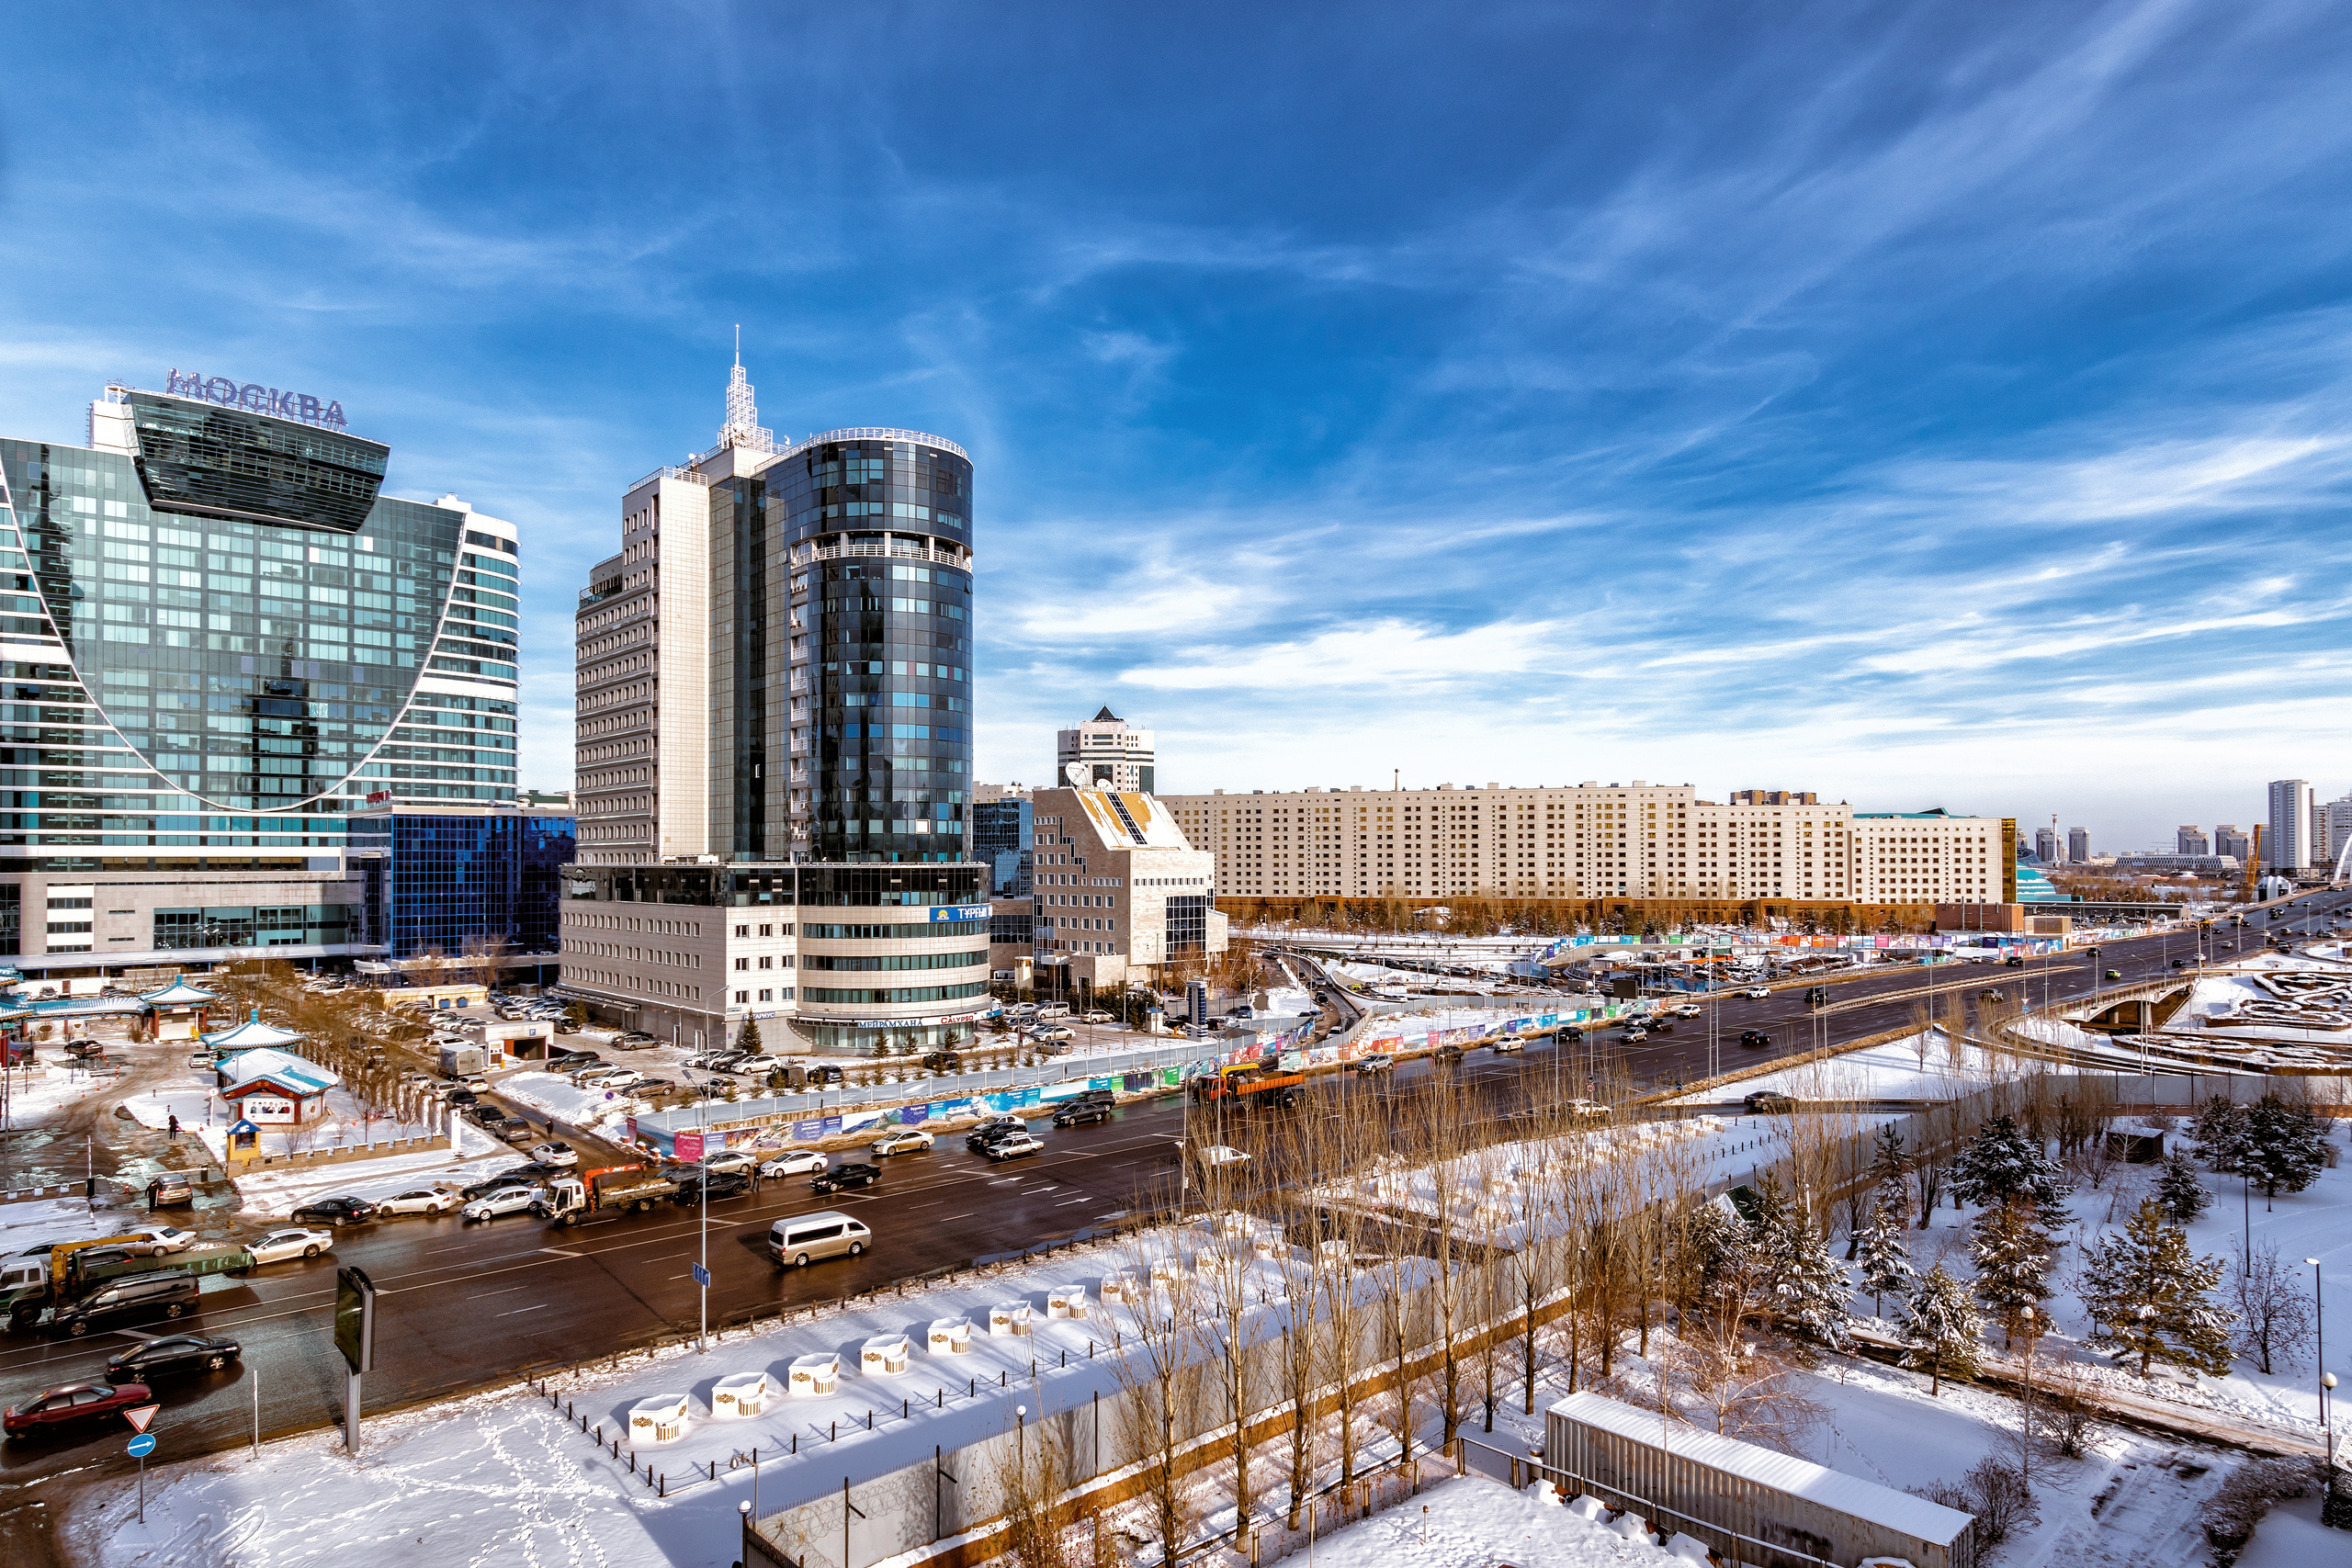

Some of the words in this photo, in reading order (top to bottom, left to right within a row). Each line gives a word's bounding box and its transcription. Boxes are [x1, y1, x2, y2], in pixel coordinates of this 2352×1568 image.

[169, 367, 349, 427] МОСКВА
[743, 1012, 775, 1021] НТАРИУС
[859, 1020, 923, 1029] МЕЙРАМХАНА
